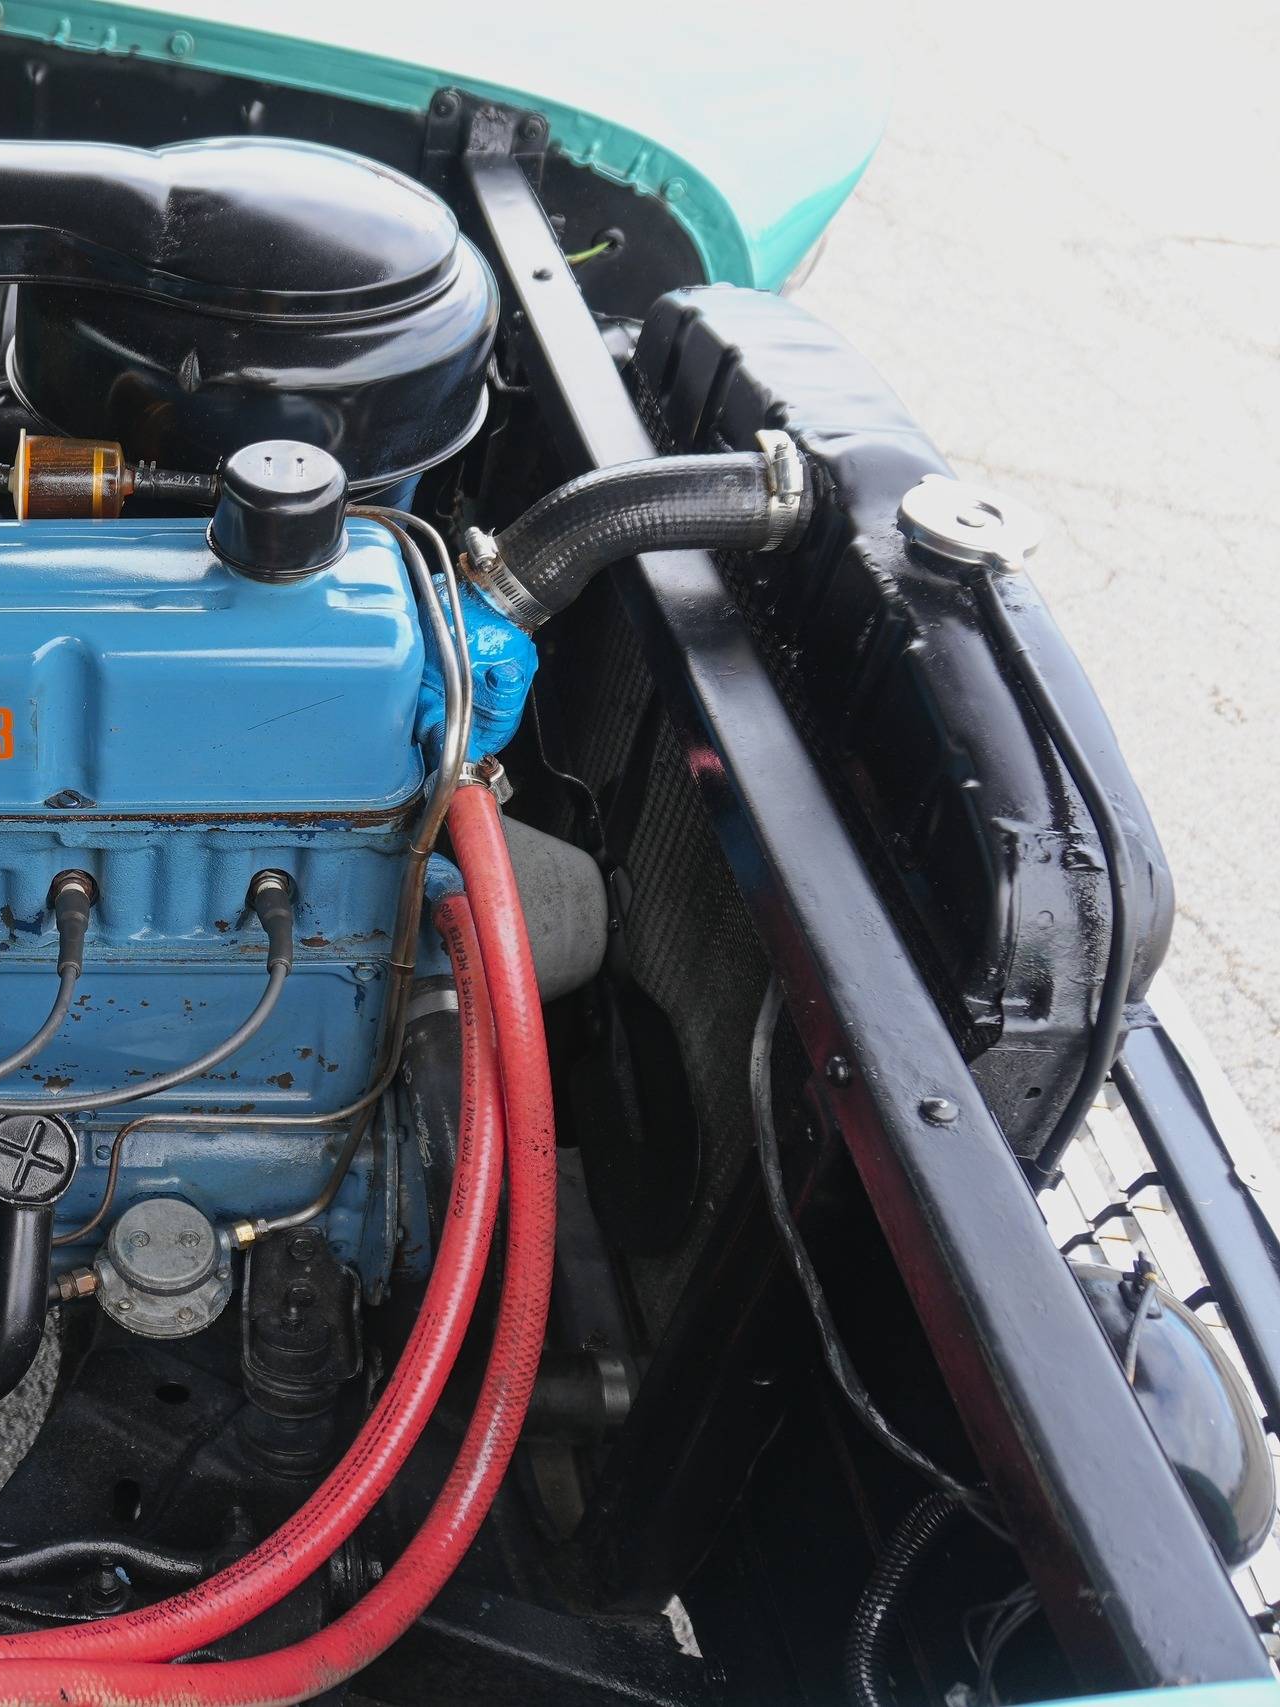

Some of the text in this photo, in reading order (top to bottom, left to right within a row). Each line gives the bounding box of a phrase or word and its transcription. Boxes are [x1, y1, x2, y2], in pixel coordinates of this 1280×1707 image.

[448, 925, 470, 971] HEATER
[461, 1095, 477, 1164] FIREWALL
[454, 1173, 470, 1218] GATES
